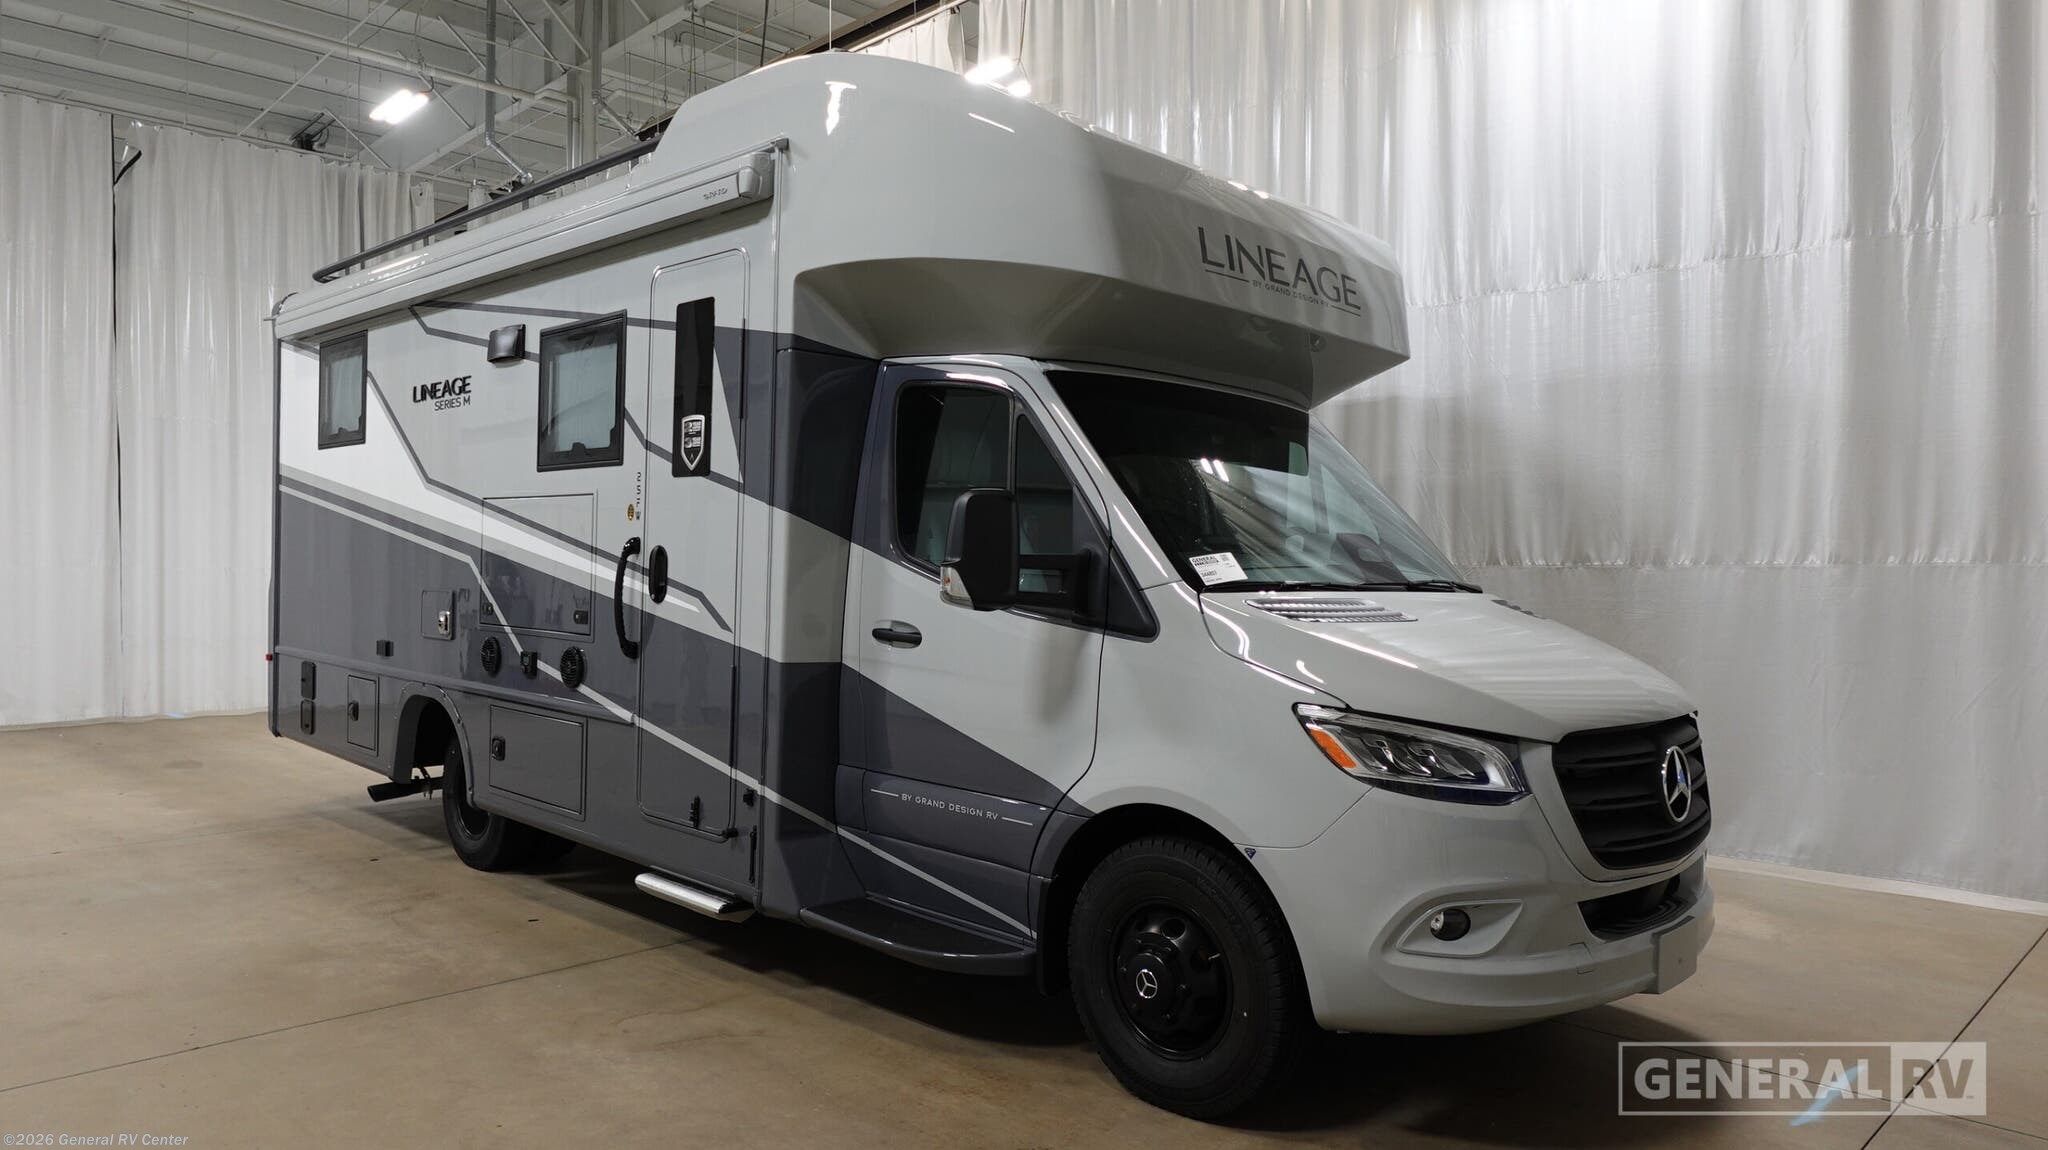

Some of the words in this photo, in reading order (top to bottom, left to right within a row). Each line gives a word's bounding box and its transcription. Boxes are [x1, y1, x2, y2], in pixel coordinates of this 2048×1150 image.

[1198, 226, 1361, 310] LINEAGE
[1264, 283, 1291, 297] GRAND
[413, 375, 472, 403] LINEAGE
[434, 397, 462, 411] SERIES
[463, 394, 471, 406] M
[901, 793, 913, 802] BY
[915, 796, 946, 810] GRAND
[949, 803, 983, 817] DESIGN
[986, 811, 999, 821] RV
